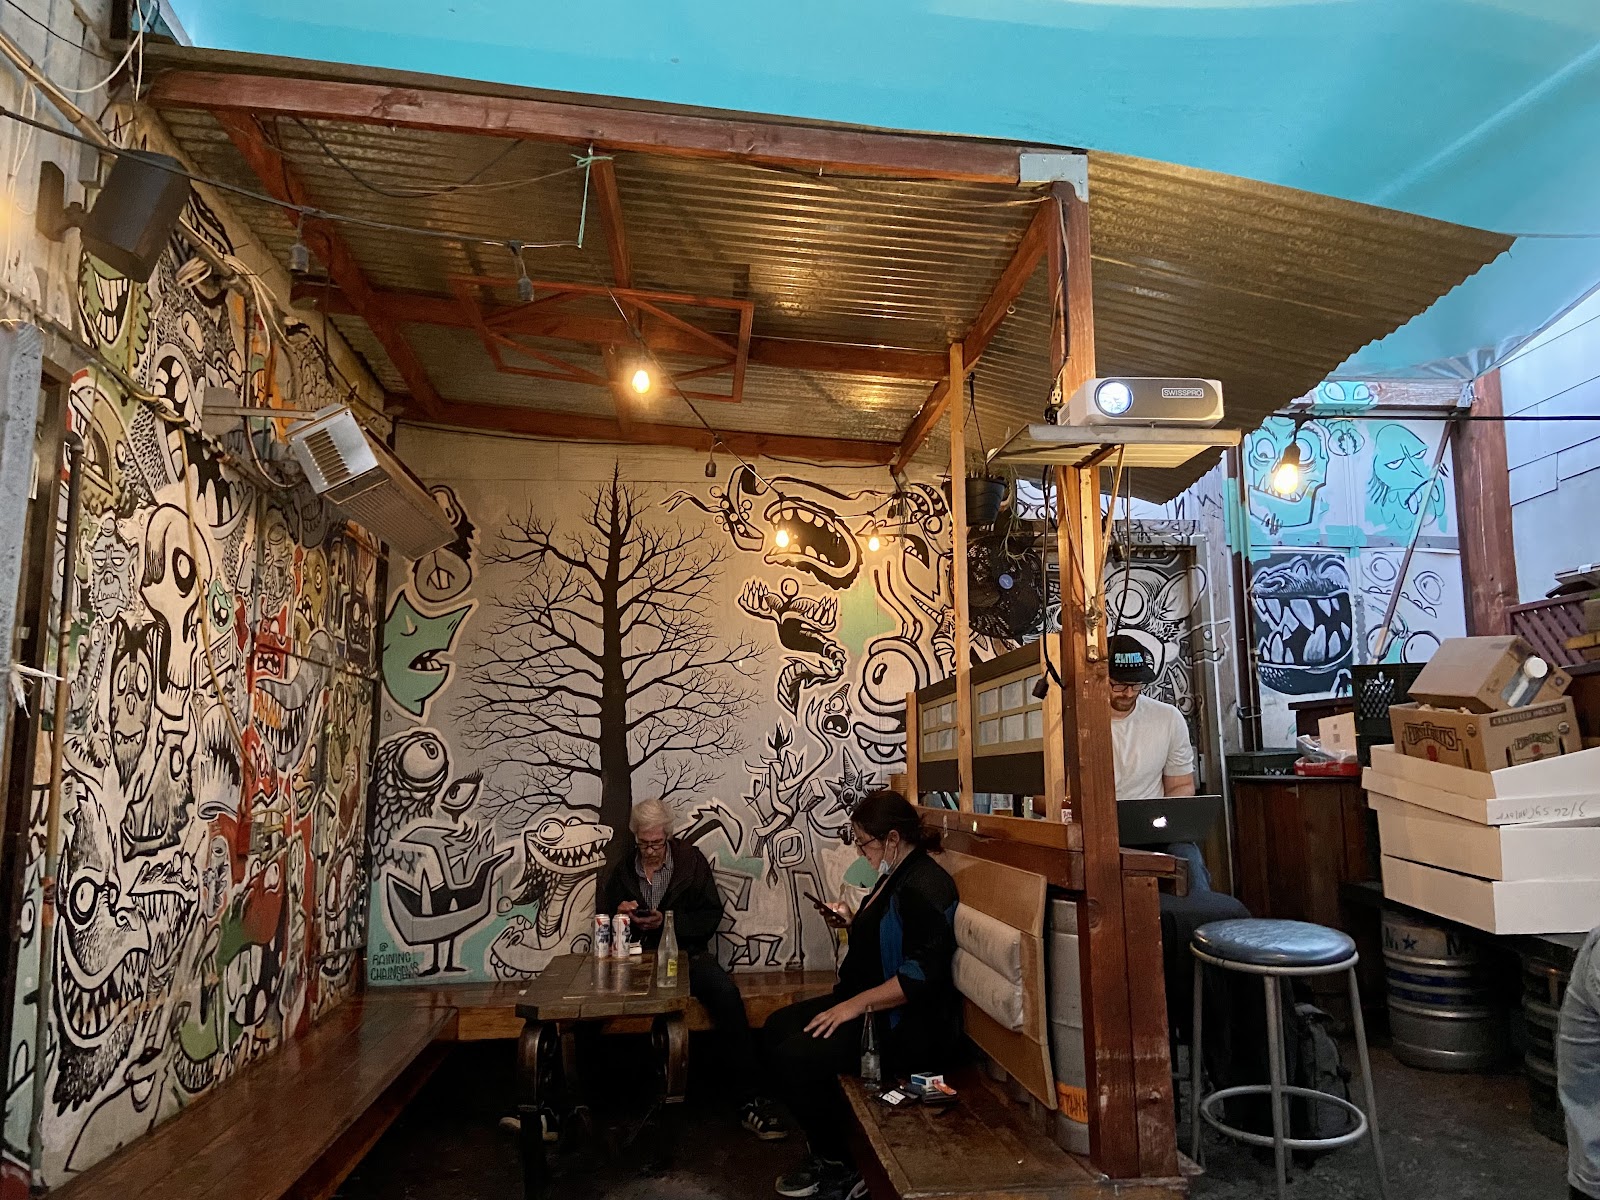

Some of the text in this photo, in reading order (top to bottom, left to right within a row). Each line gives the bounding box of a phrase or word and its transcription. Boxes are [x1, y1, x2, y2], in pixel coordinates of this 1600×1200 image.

[1163, 389, 1202, 397] SWISSPRO
[1554, 800, 1587, 817] 3/26
[379, 942, 388, 951] @
[372, 951, 411, 965] RAINING
[370, 961, 420, 981] CHAINSAWS
